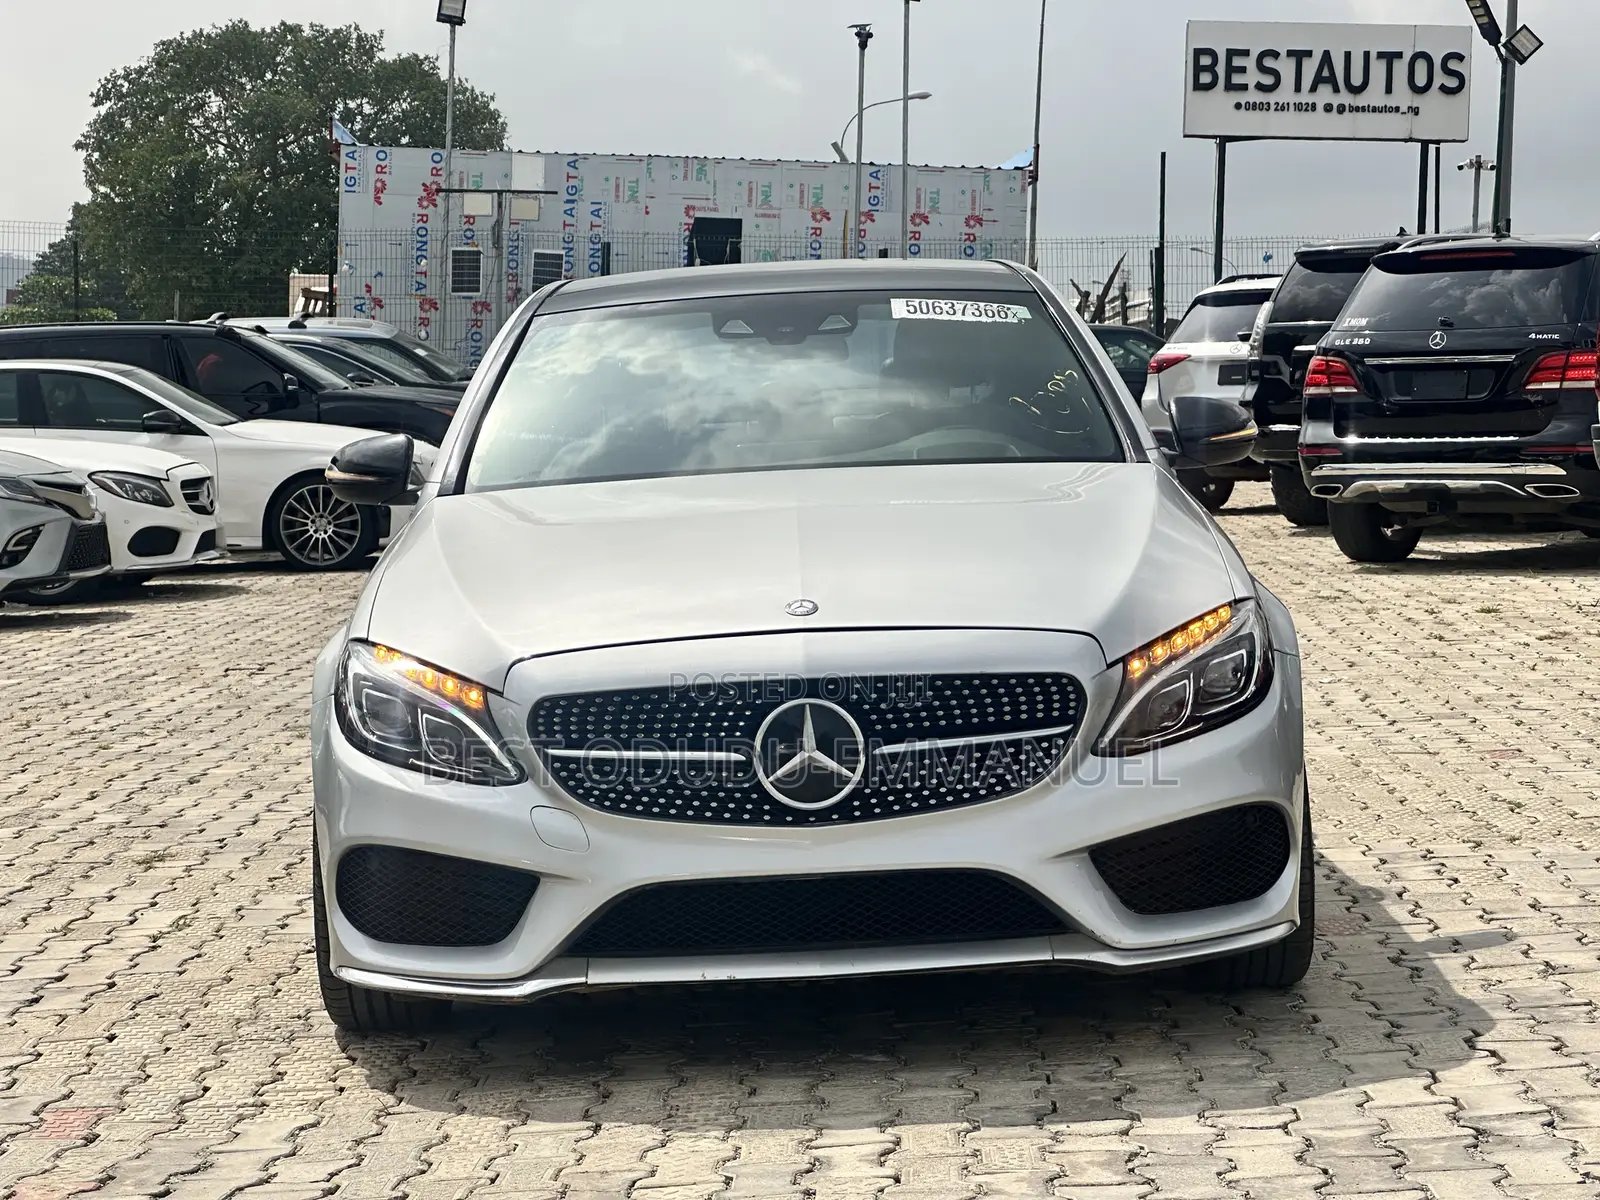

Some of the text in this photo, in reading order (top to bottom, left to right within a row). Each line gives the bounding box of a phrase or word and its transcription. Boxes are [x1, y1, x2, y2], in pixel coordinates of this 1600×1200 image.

[1192, 47, 1466, 95] BESTAUTOS
[1244, 101, 1271, 112] 0803
[1274, 101, 1290, 112] 261
[1293, 102, 1317, 112] 1028
